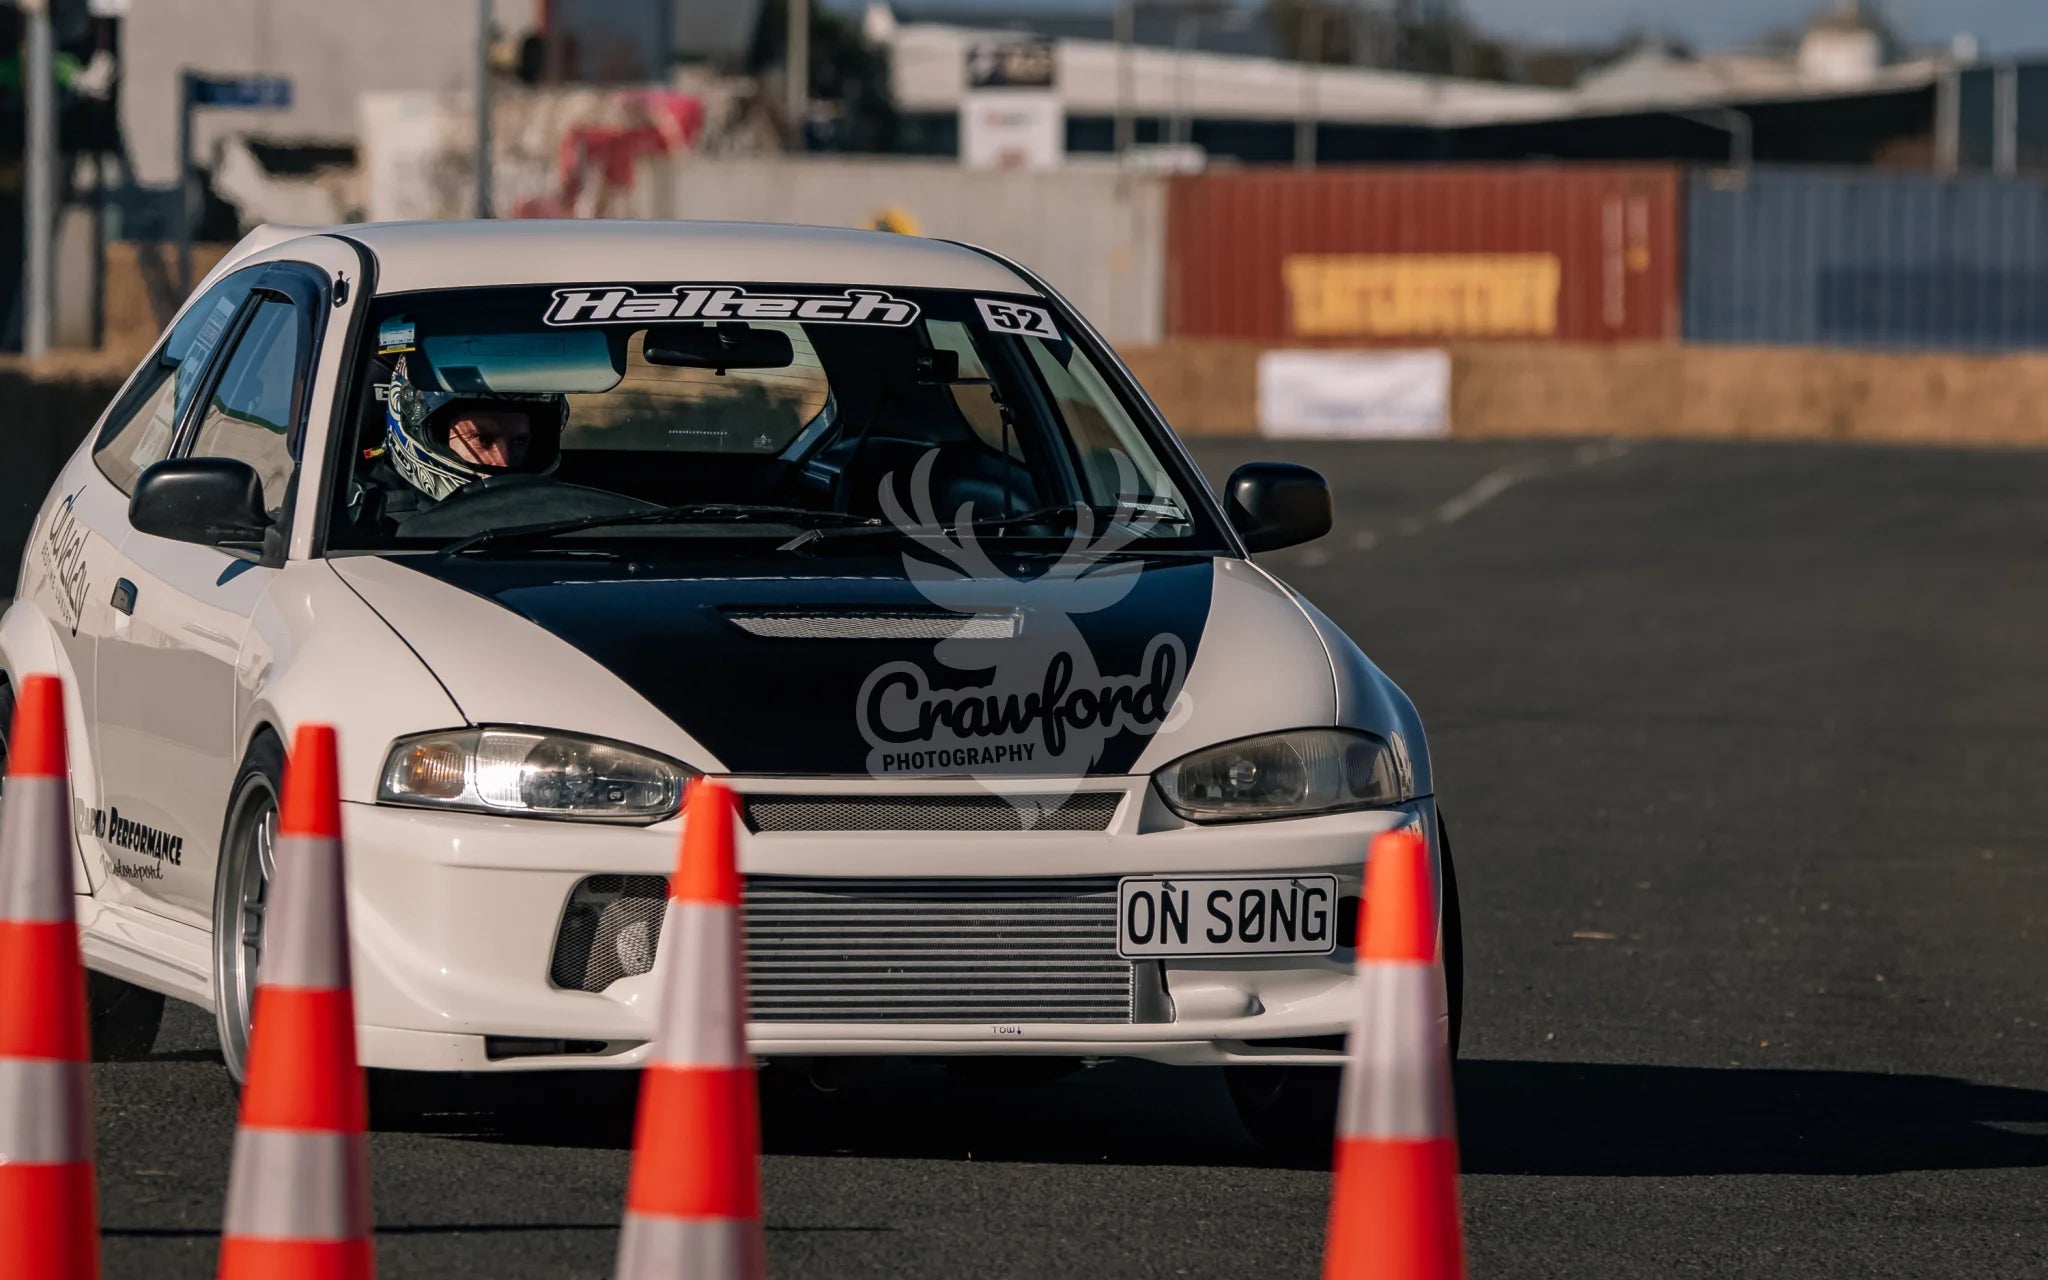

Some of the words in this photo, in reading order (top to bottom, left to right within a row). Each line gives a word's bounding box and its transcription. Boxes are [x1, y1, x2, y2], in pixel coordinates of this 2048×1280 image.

[552, 288, 912, 323] Haltech
[987, 303, 1049, 334] 52
[108, 806, 183, 867] PERFORMANCE
[1127, 889, 1189, 945] ON
